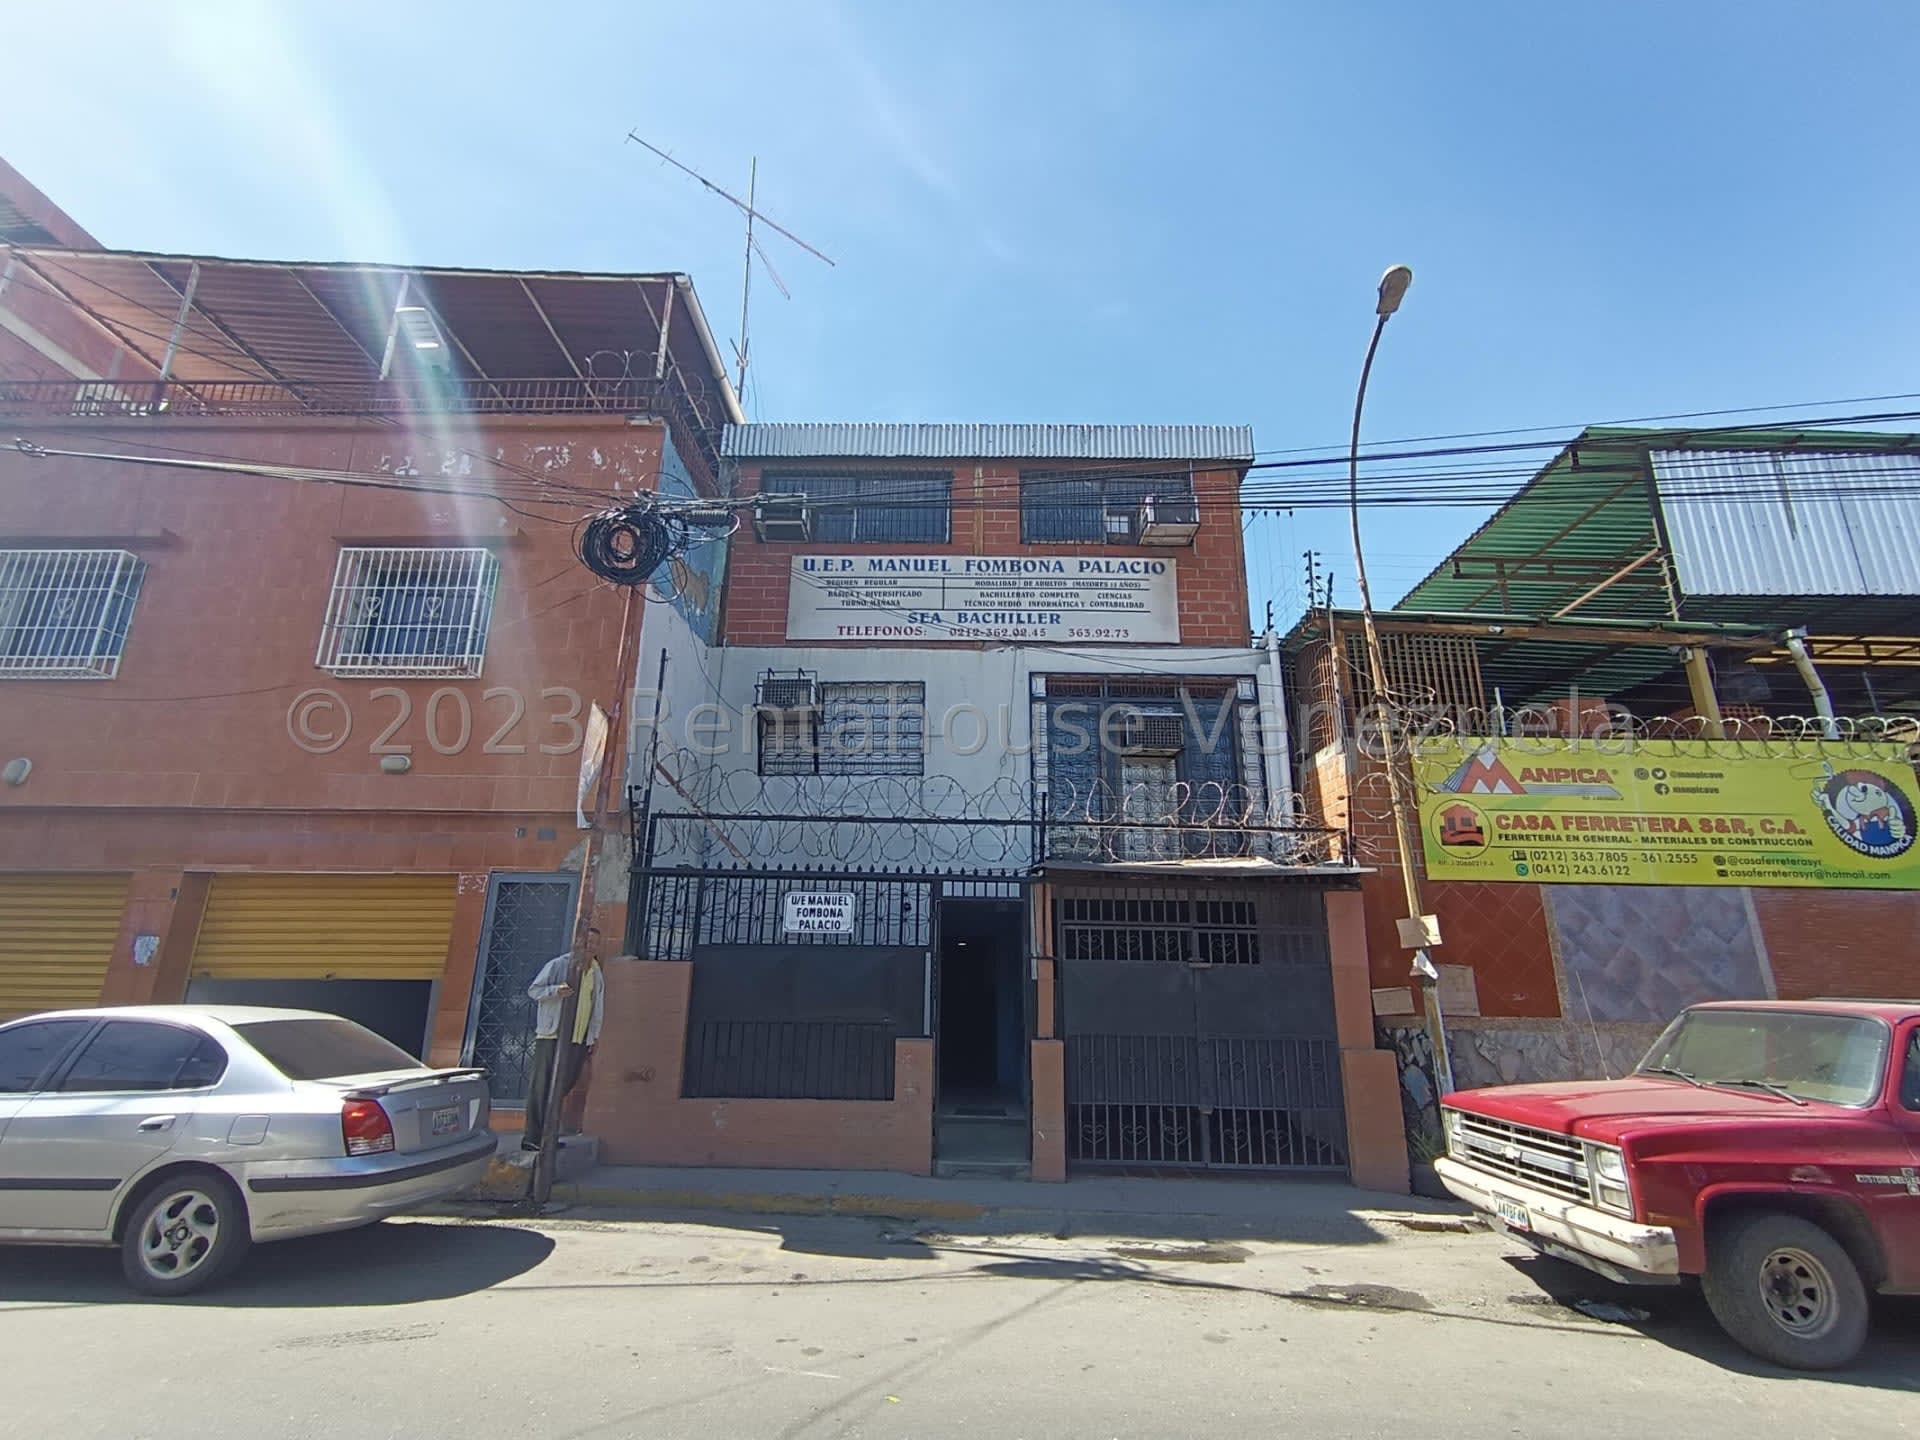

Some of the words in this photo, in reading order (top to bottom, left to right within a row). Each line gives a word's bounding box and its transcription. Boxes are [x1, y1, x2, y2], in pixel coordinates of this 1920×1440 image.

[803, 558, 855, 572] U.E.P.
[868, 558, 951, 572] MANUEL
[965, 559, 1065, 573] FOMBONA
[1079, 560, 1166, 575] PALACIO
[865, 590, 922, 598] DIVERSIFICADO
[980, 591, 1036, 599] BACHILLERATO
[1040, 591, 1080, 599] COMPLETO
[1097, 592, 1132, 600] CIENCIAS
[1090, 601, 1145, 609] CONTABILIDAD
[908, 612, 942, 624] SEA
[957, 612, 1061, 625] BACHILLER
[837, 625, 927, 636] TELEFONOS:
[1068, 628, 1129, 638] 363.92.73
[1495, 814, 1554, 831] CASA
[1561, 815, 1694, 833] FERRETERA
[1698, 817, 1754, 836] S&R,
[1759, 818, 1806, 835] C.A.
[1566, 834, 1580, 842] EN
[1583, 834, 1632, 844] GENERAL
[1641, 835, 1708, 845] MATERIALES
[1711, 836, 1724, 845] DE
[1728, 836, 1813, 846] CONSTRUCCIÓN
[1827, 816, 1869, 852] CALIDAD
[1529, 850, 1568, 863] (0212)
[1572, 851, 1628, 863] 363.7805
[1641, 853, 1698, 864] 361.2555
[1532, 864, 1570, 876] (0412)
[1575, 864, 1630, 876] 243.6122
[808, 895, 849, 906] MANUEL
[796, 907, 844, 918] FOMBONA
[799, 919, 841, 930] PALACIO
